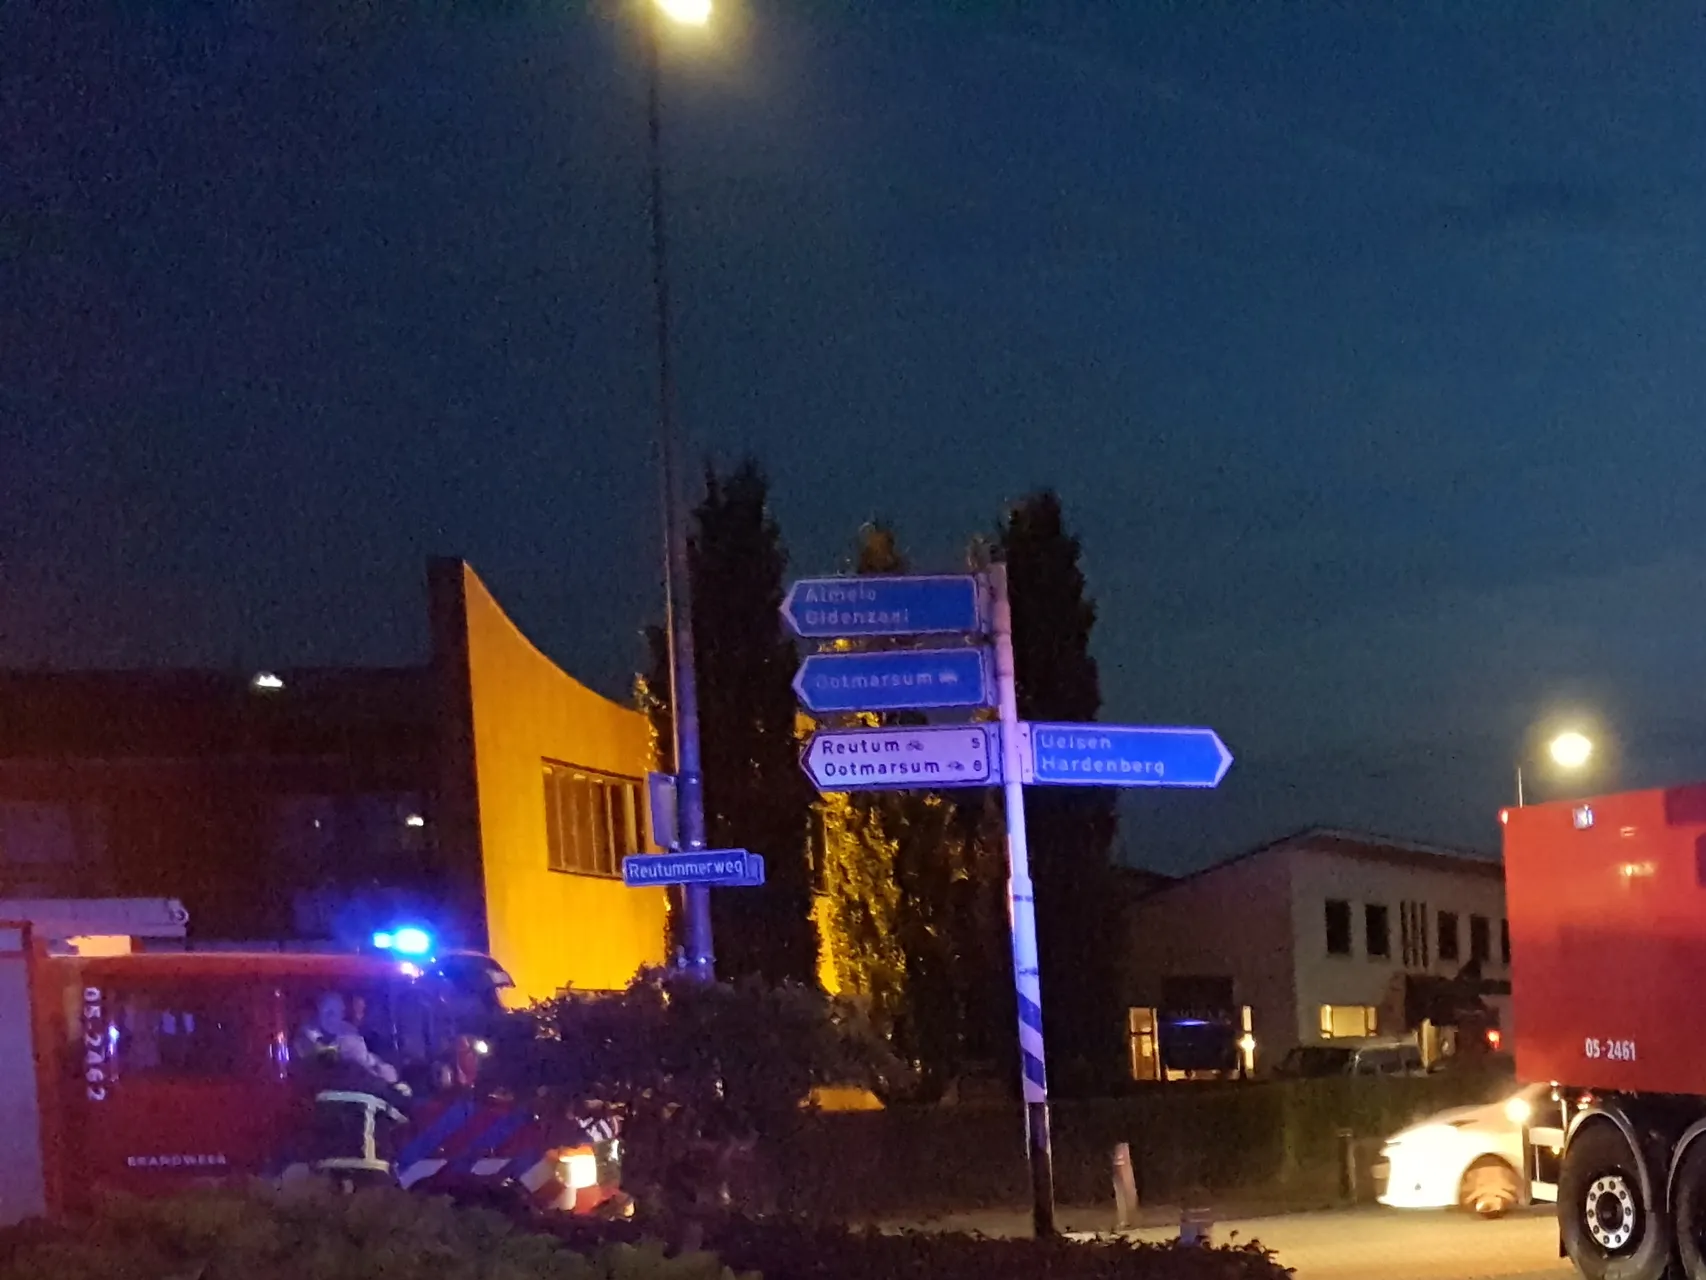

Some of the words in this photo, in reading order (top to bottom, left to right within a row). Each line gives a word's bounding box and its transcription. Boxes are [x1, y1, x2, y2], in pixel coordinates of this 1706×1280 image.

[816, 671, 933, 689] Ootmarsum
[822, 739, 900, 755] Reutum
[1041, 734, 1111, 749] Uelsen
[824, 760, 940, 777] Ootmarsum
[1042, 756, 1165, 777] Hardenberg
[629, 860, 743, 879] Reutummerweg
[1584, 1037, 1637, 1061] 05-2461
